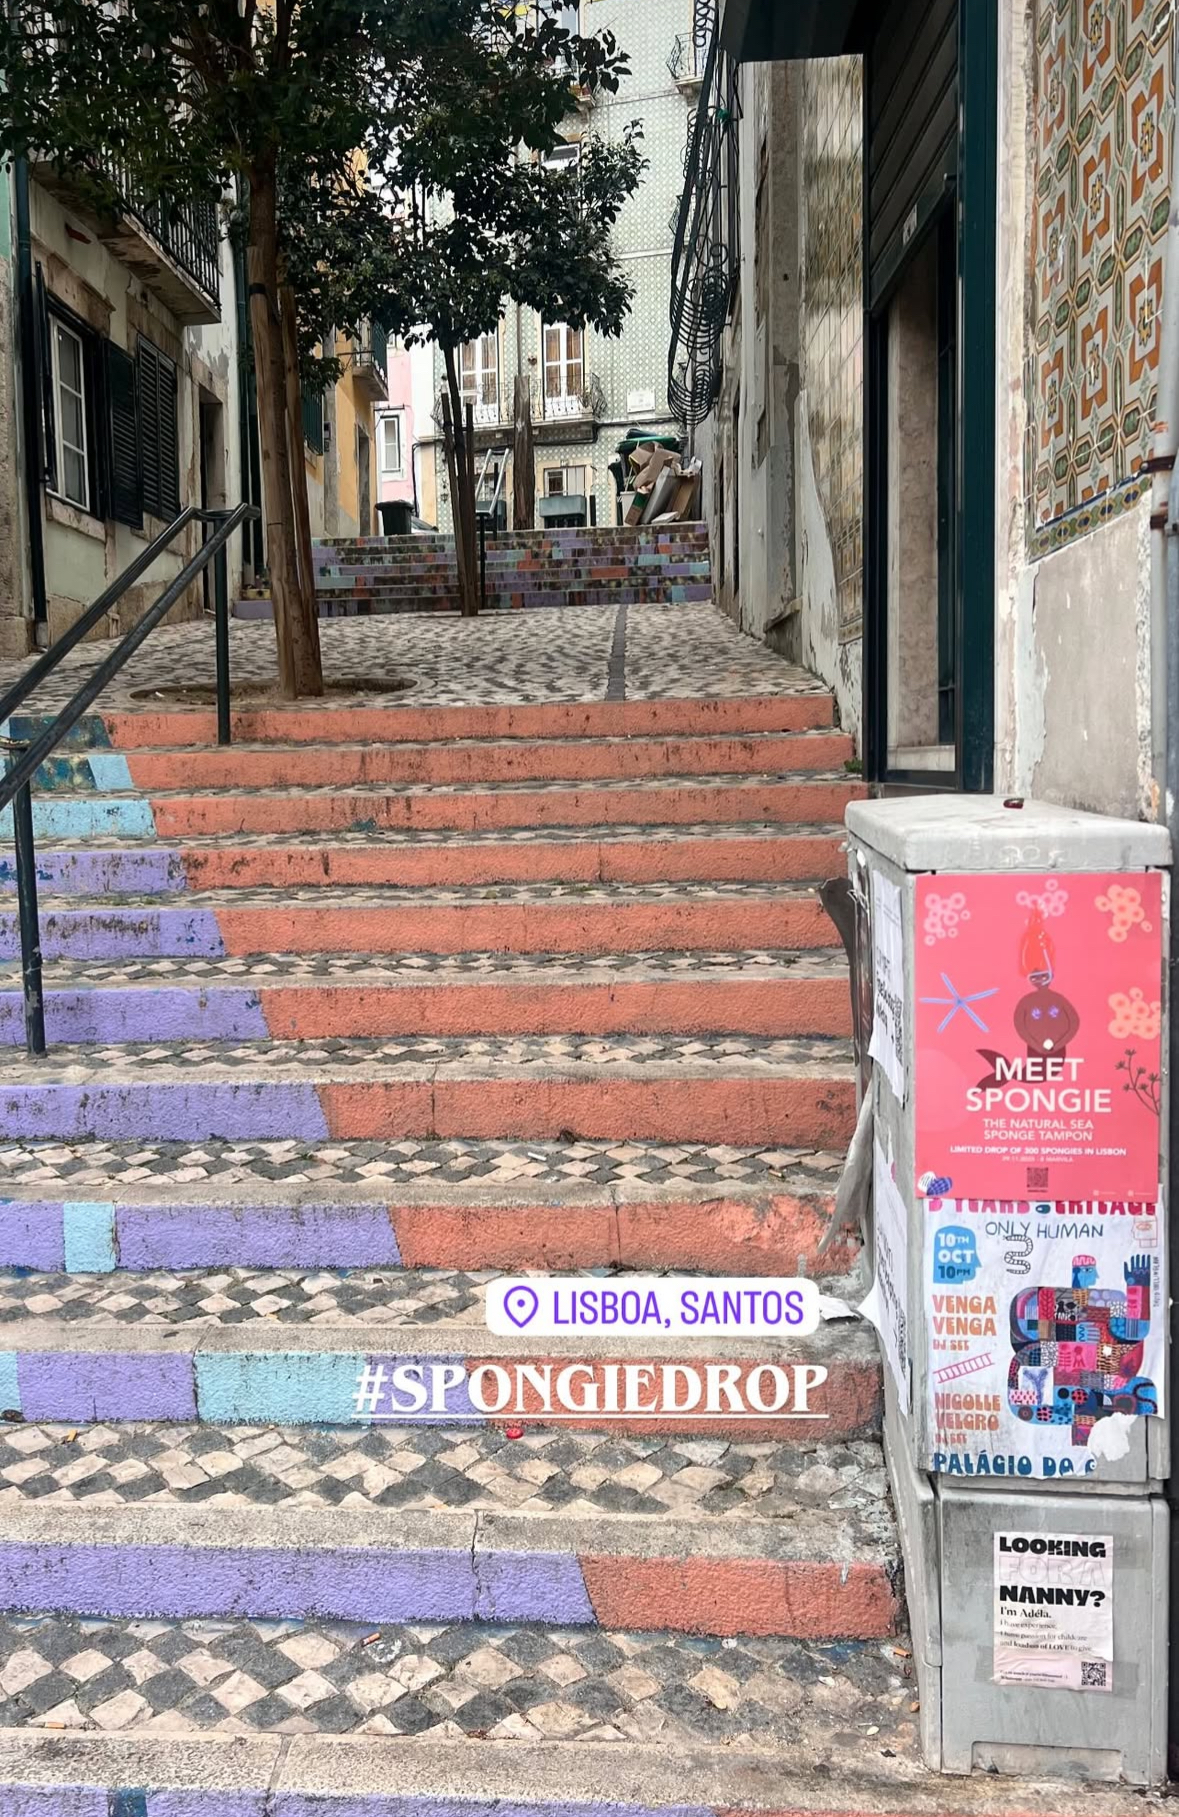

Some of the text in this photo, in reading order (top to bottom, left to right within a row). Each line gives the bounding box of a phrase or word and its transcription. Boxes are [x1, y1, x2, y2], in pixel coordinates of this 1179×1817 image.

[995, 1057, 1084, 1082] MEET
[966, 1088, 1112, 1113] SPONGIE
[982, 1118, 1094, 1130] THE NATURAL SEA
[984, 1130, 1092, 1142] SPONGE TAMPON
[950, 1146, 982, 1154] LIMITED
[984, 1146, 1008, 1154] DROP
[1010, 1146, 1022, 1155] OF
[1041, 1146, 1083, 1156] SPONGIES
[1084, 1148, 1094, 1156] IN
[1096, 1148, 1126, 1156] LISBON
[938, 1232, 969, 1245] 10TH
[985, 1221, 1103, 1239] ONLY HUMAN
[938, 1250, 974, 1263] OCT
[938, 1266, 971, 1279] 10PM
[932, 1294, 997, 1315] VENGA
[932, 1316, 997, 1336] VENGA
[950, 1339, 970, 1351] SET
[1000, 1536, 1106, 1558] LOOKING
[999, 1556, 1105, 1587] FOR A
[1000, 1585, 1106, 1608] NANNY?
